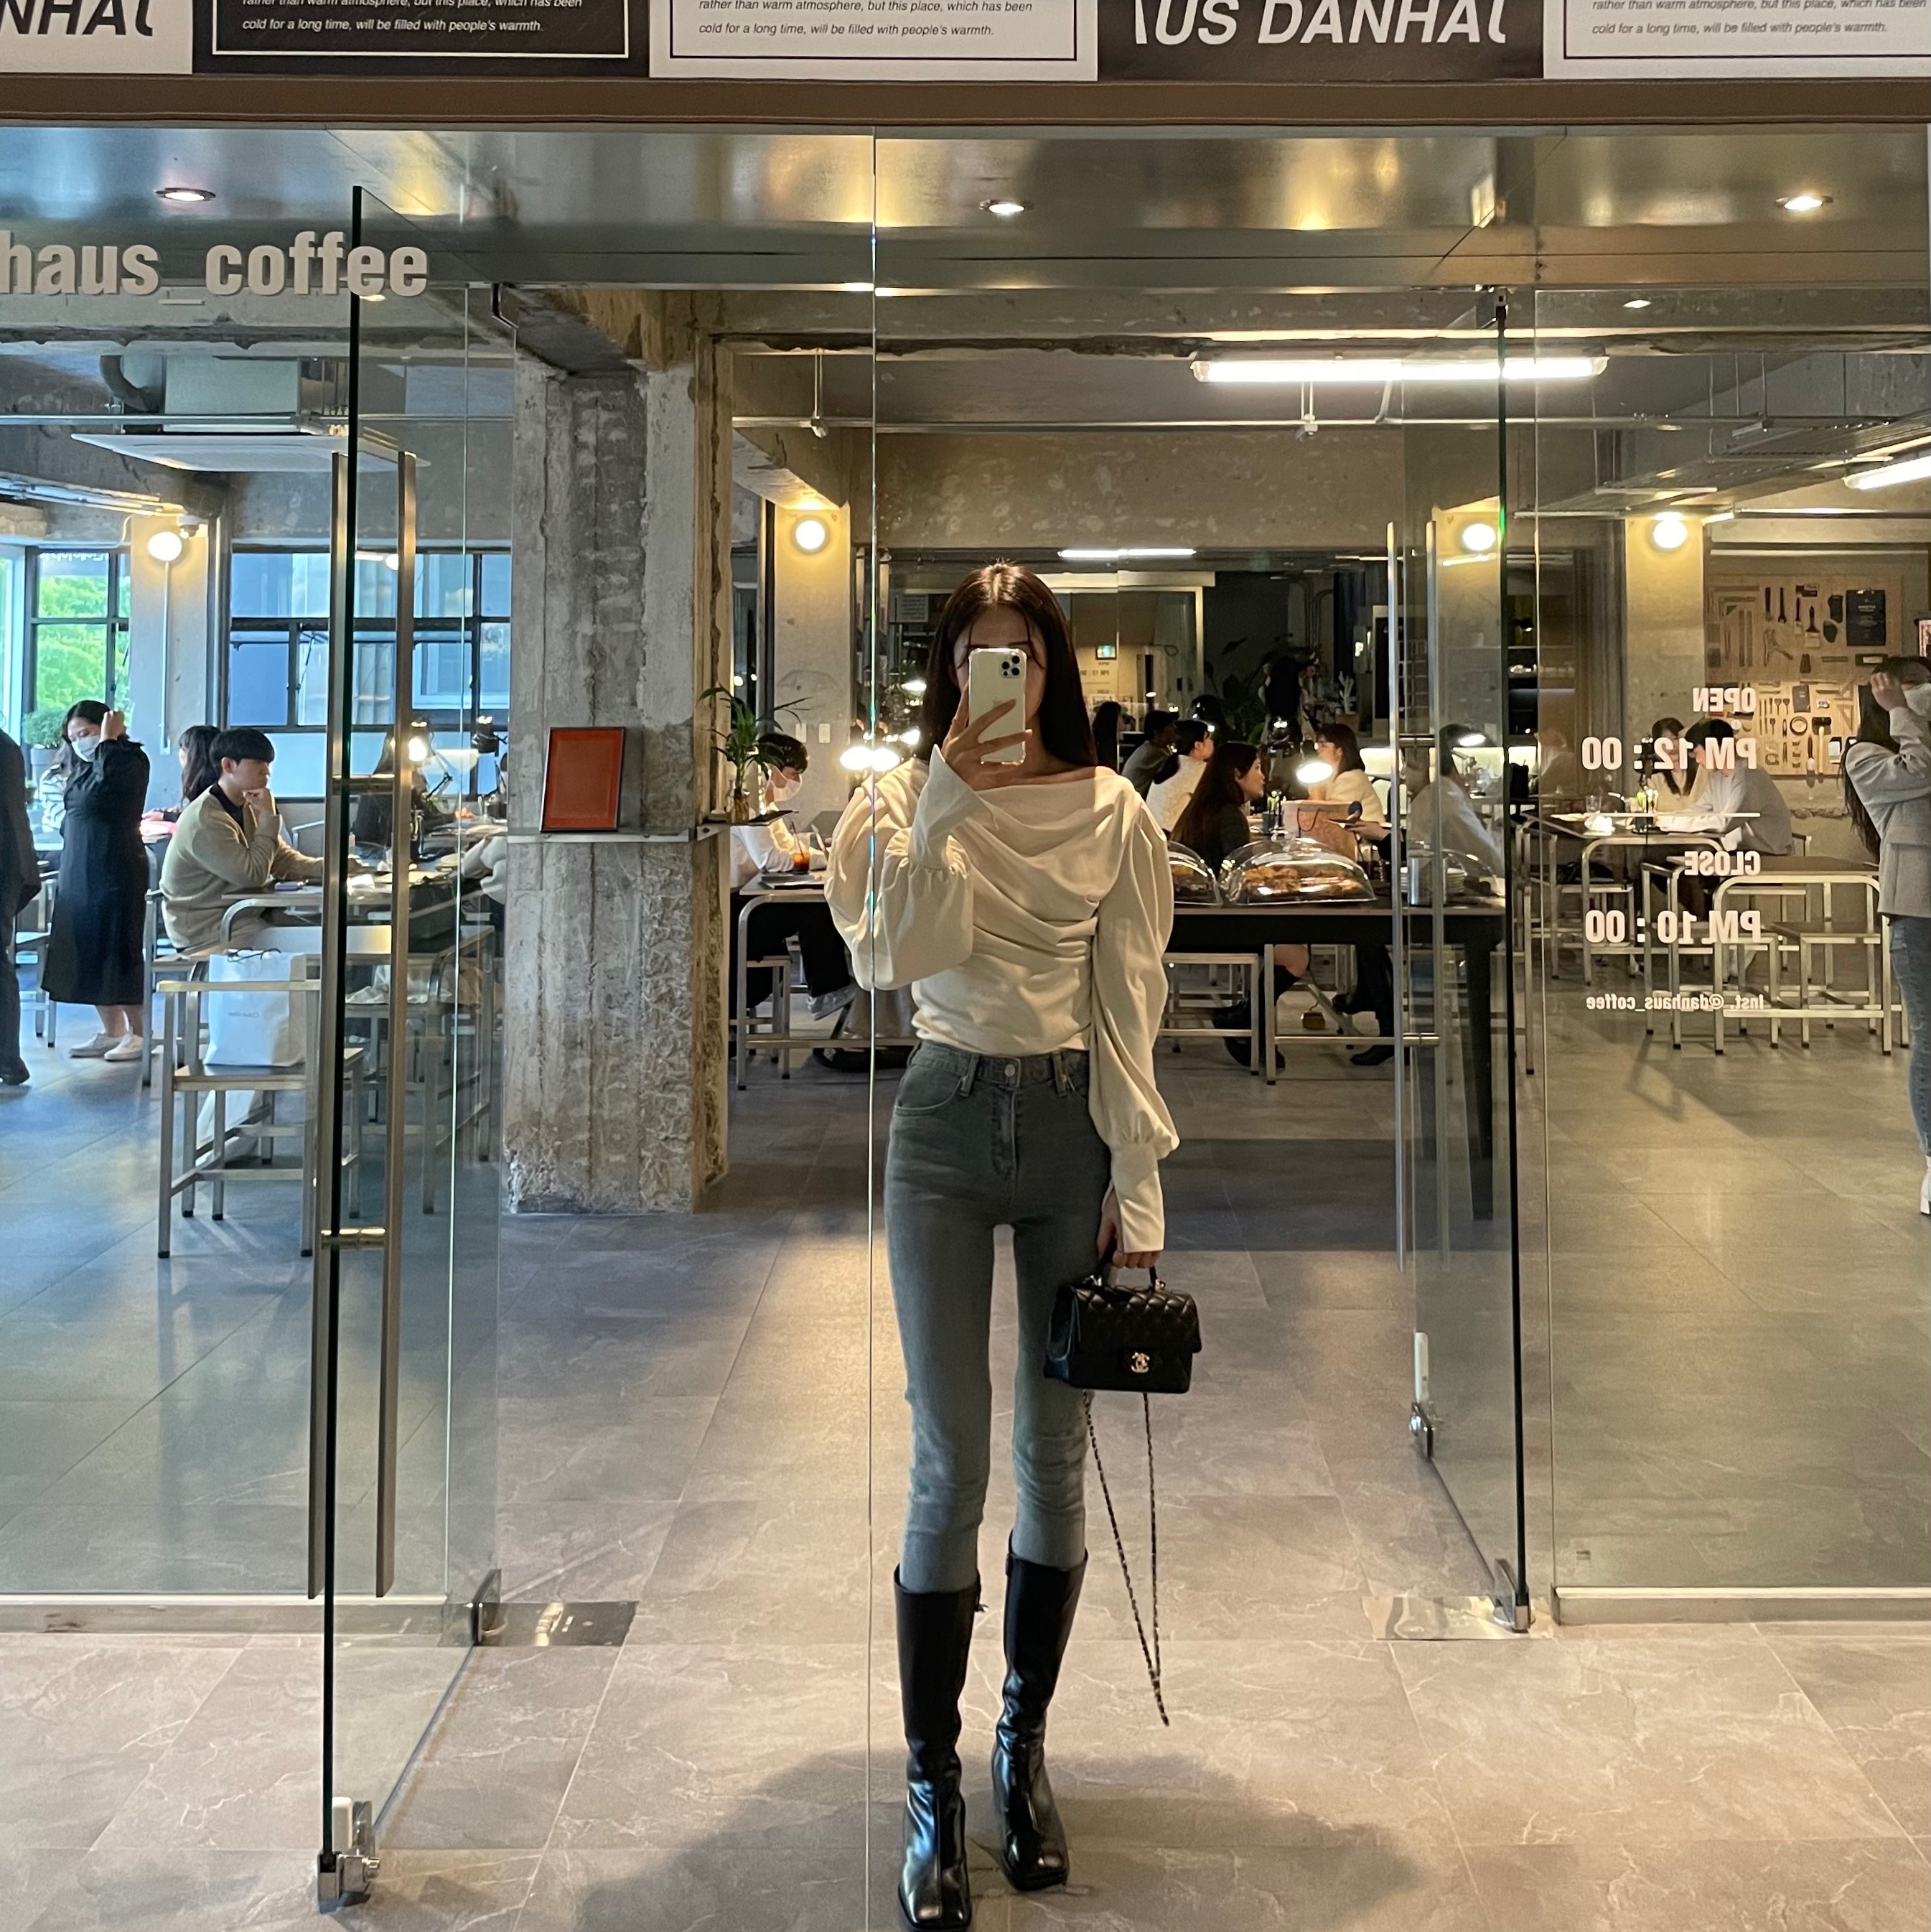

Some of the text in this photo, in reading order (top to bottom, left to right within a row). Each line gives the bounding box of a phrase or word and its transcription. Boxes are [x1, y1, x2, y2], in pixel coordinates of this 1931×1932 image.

[698, 0, 1032, 13] rather than warm atmosphere, but this place, which has been
[1592, 0, 1625, 9] rather
[1628, 0, 1652, 9] than
[1688, 0, 1757, 11] atmosphere,
[1760, 0, 1778, 9] but
[1781, 0, 1801, 9] this
[1803, 0, 1836, 10] place,
[242, 19, 268, 29] cold
[269, 19, 286, 29] for
[287, 21, 295, 29] a
[297, 19, 322, 32] long
[324, 19, 352, 31] time,
[356, 19, 375, 29] will
[376, 19, 391, 30] be
[394, 19, 421, 30] filled
[424, 19, 446, 30] with
[448, 19, 496, 32] people's
[698, 23, 722, 34] cold
[725, 22, 741, 33] for
[754, 23, 777, 36] long
[780, 23, 806, 35] time,
[810, 23, 828, 34] will
[831, 24, 845, 34] be
[848, 24, 874, 34] filled
[877, 24, 898, 34] with
[901, 24, 948, 37] people's
[951, 25, 994, 35] warmth.
[1592, 23, 1615, 34] cold
[1618, 23, 1634, 34] for
[1646, 23, 1669, 36] long
[1673, 23, 1699, 34] time,
[1703, 22, 1721, 33] will
[1724, 22, 1738, 33] be
[1741, 22, 1767, 33] filled
[1770, 22, 1792, 32] with
[1795, 22, 1841, 34] people's
[1844, 22, 1887, 32] warmth.
